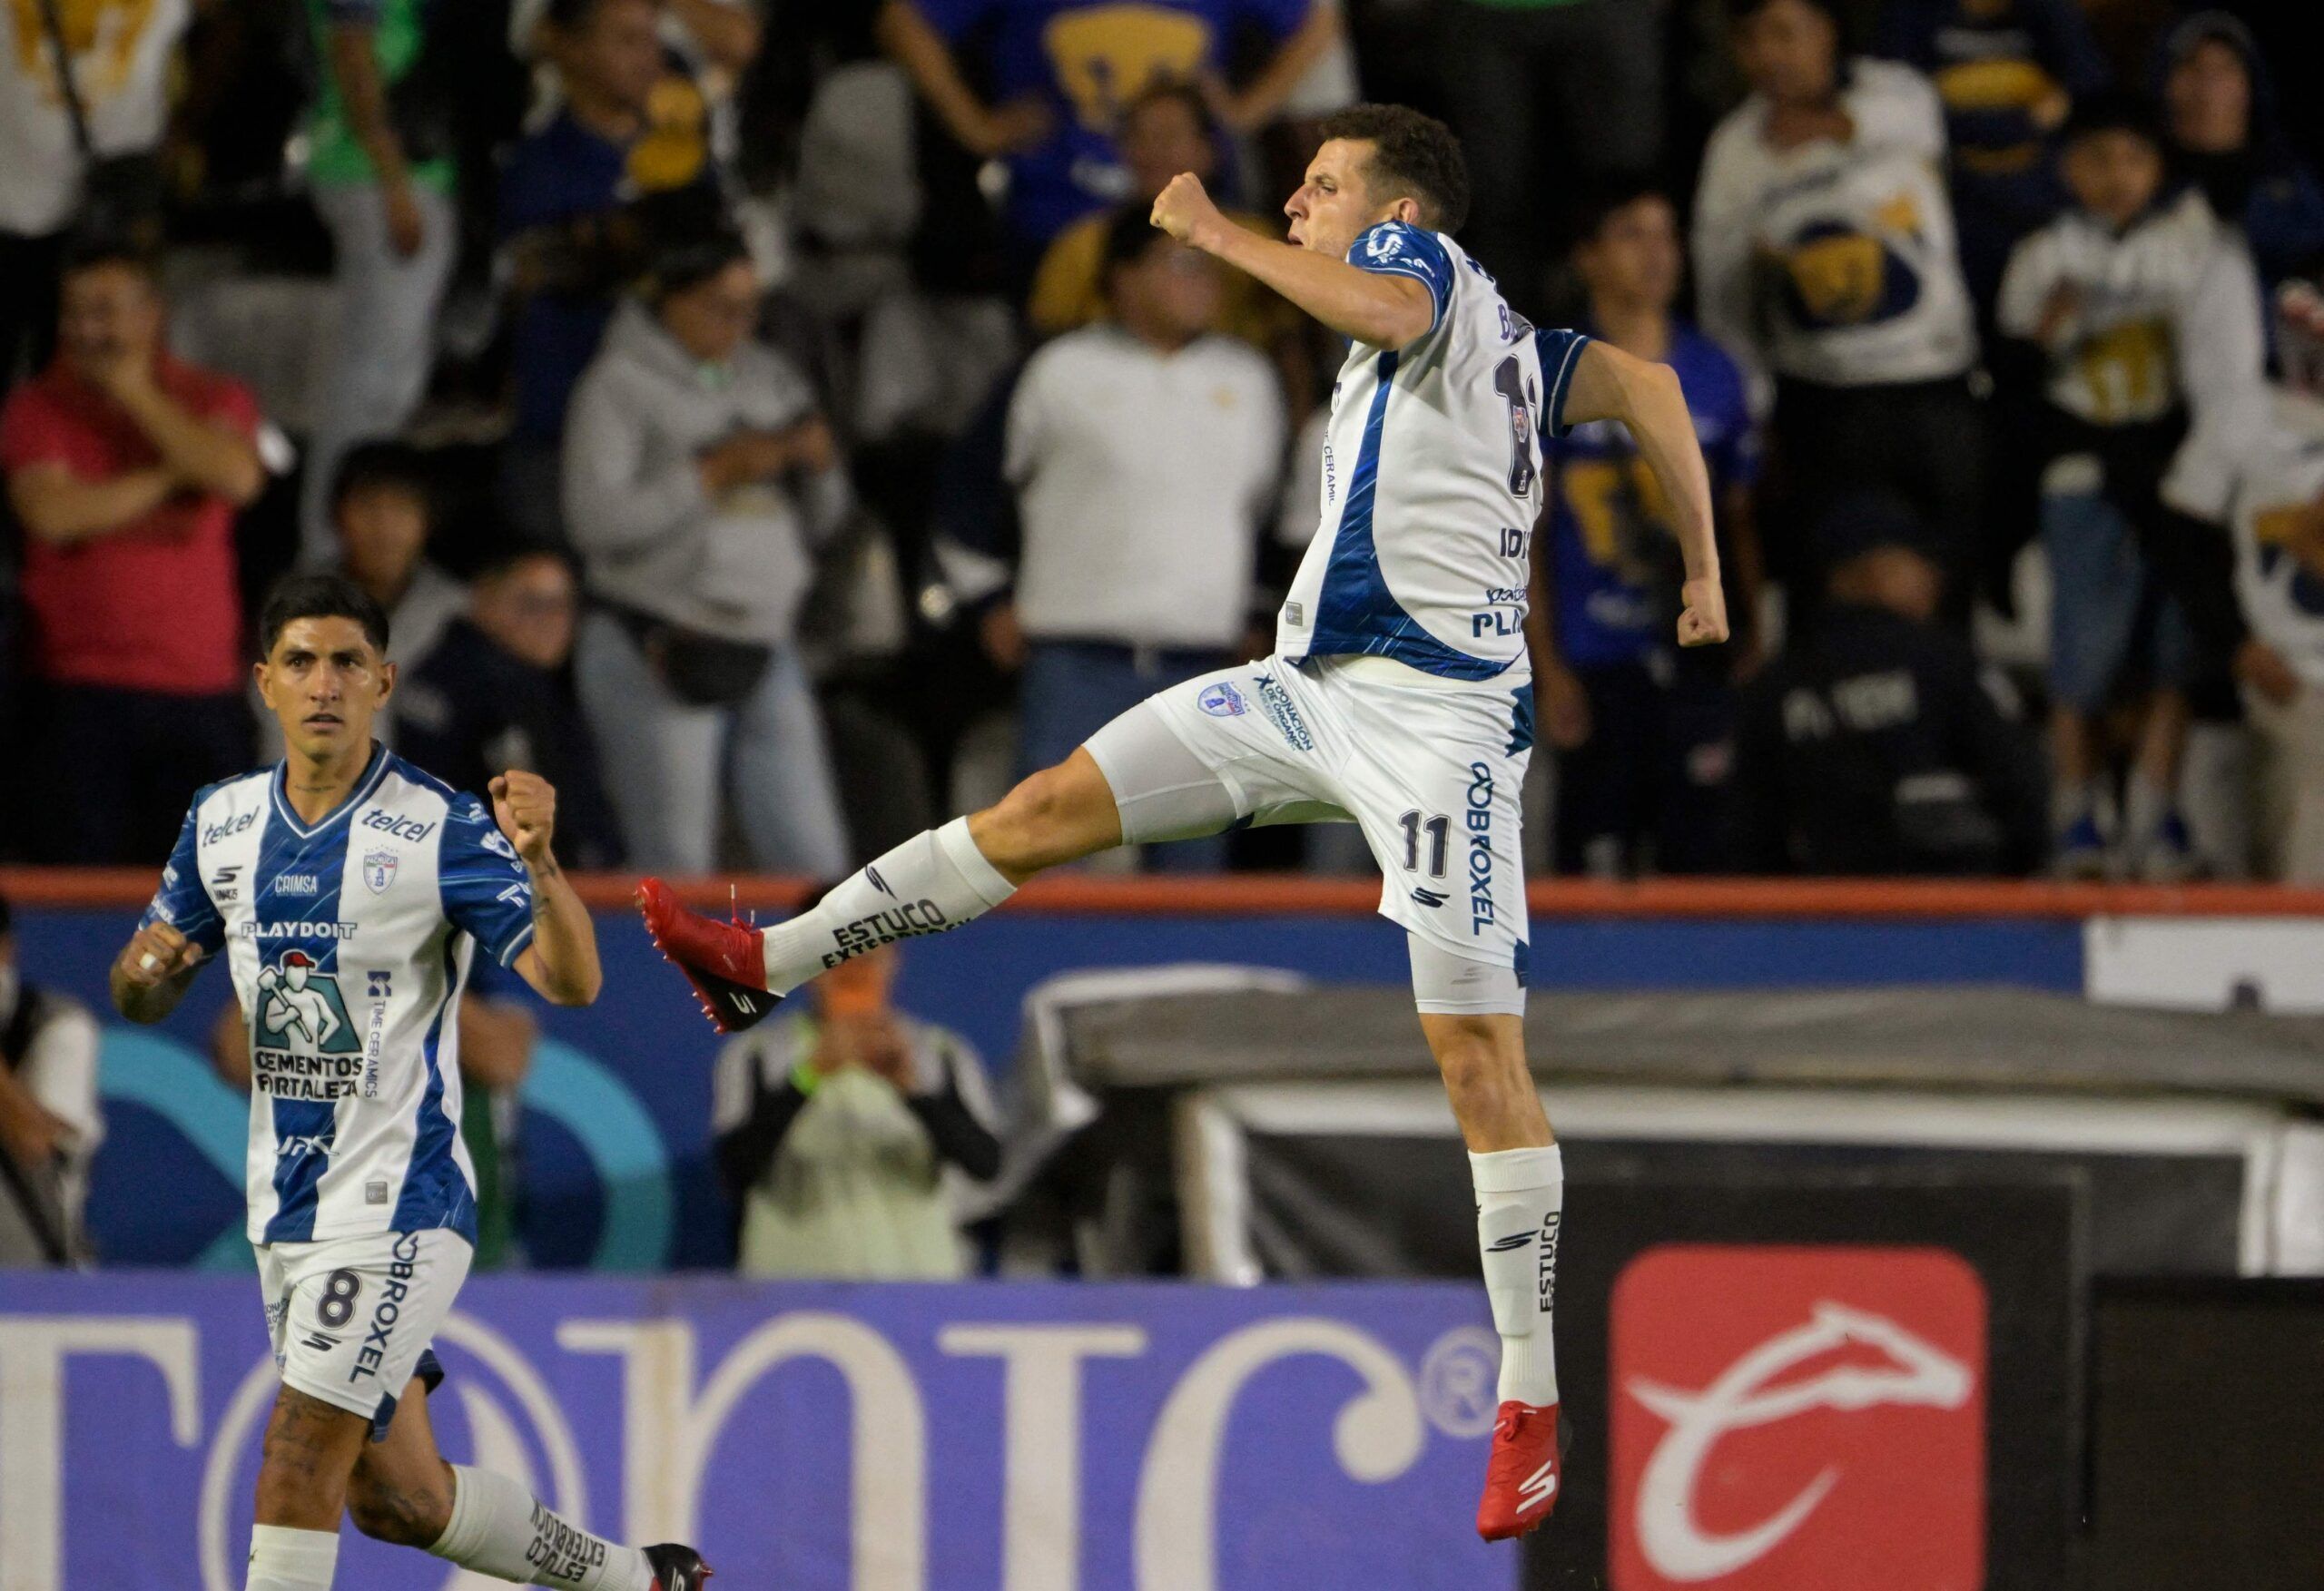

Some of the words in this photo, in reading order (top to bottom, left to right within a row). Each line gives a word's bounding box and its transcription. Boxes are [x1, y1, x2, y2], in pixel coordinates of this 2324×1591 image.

[202, 805, 261, 848] telcel
[361, 808, 436, 843] telcel
[1398, 809, 1452, 879] 11
[241, 920, 358, 940] PLAYDOIT
[832, 899, 947, 948] ESTUCO
[370, 1000, 387, 1029] TIME
[254, 1050, 364, 1077] CEMENTOS
[364, 1031, 380, 1098] CERAMICS
[1540, 1211, 1561, 1312] ESTUCO
[316, 1268, 362, 1331] 8
[349, 1231, 419, 1384] OBROXEL
[525, 1536, 588, 1584] ESTUCO
